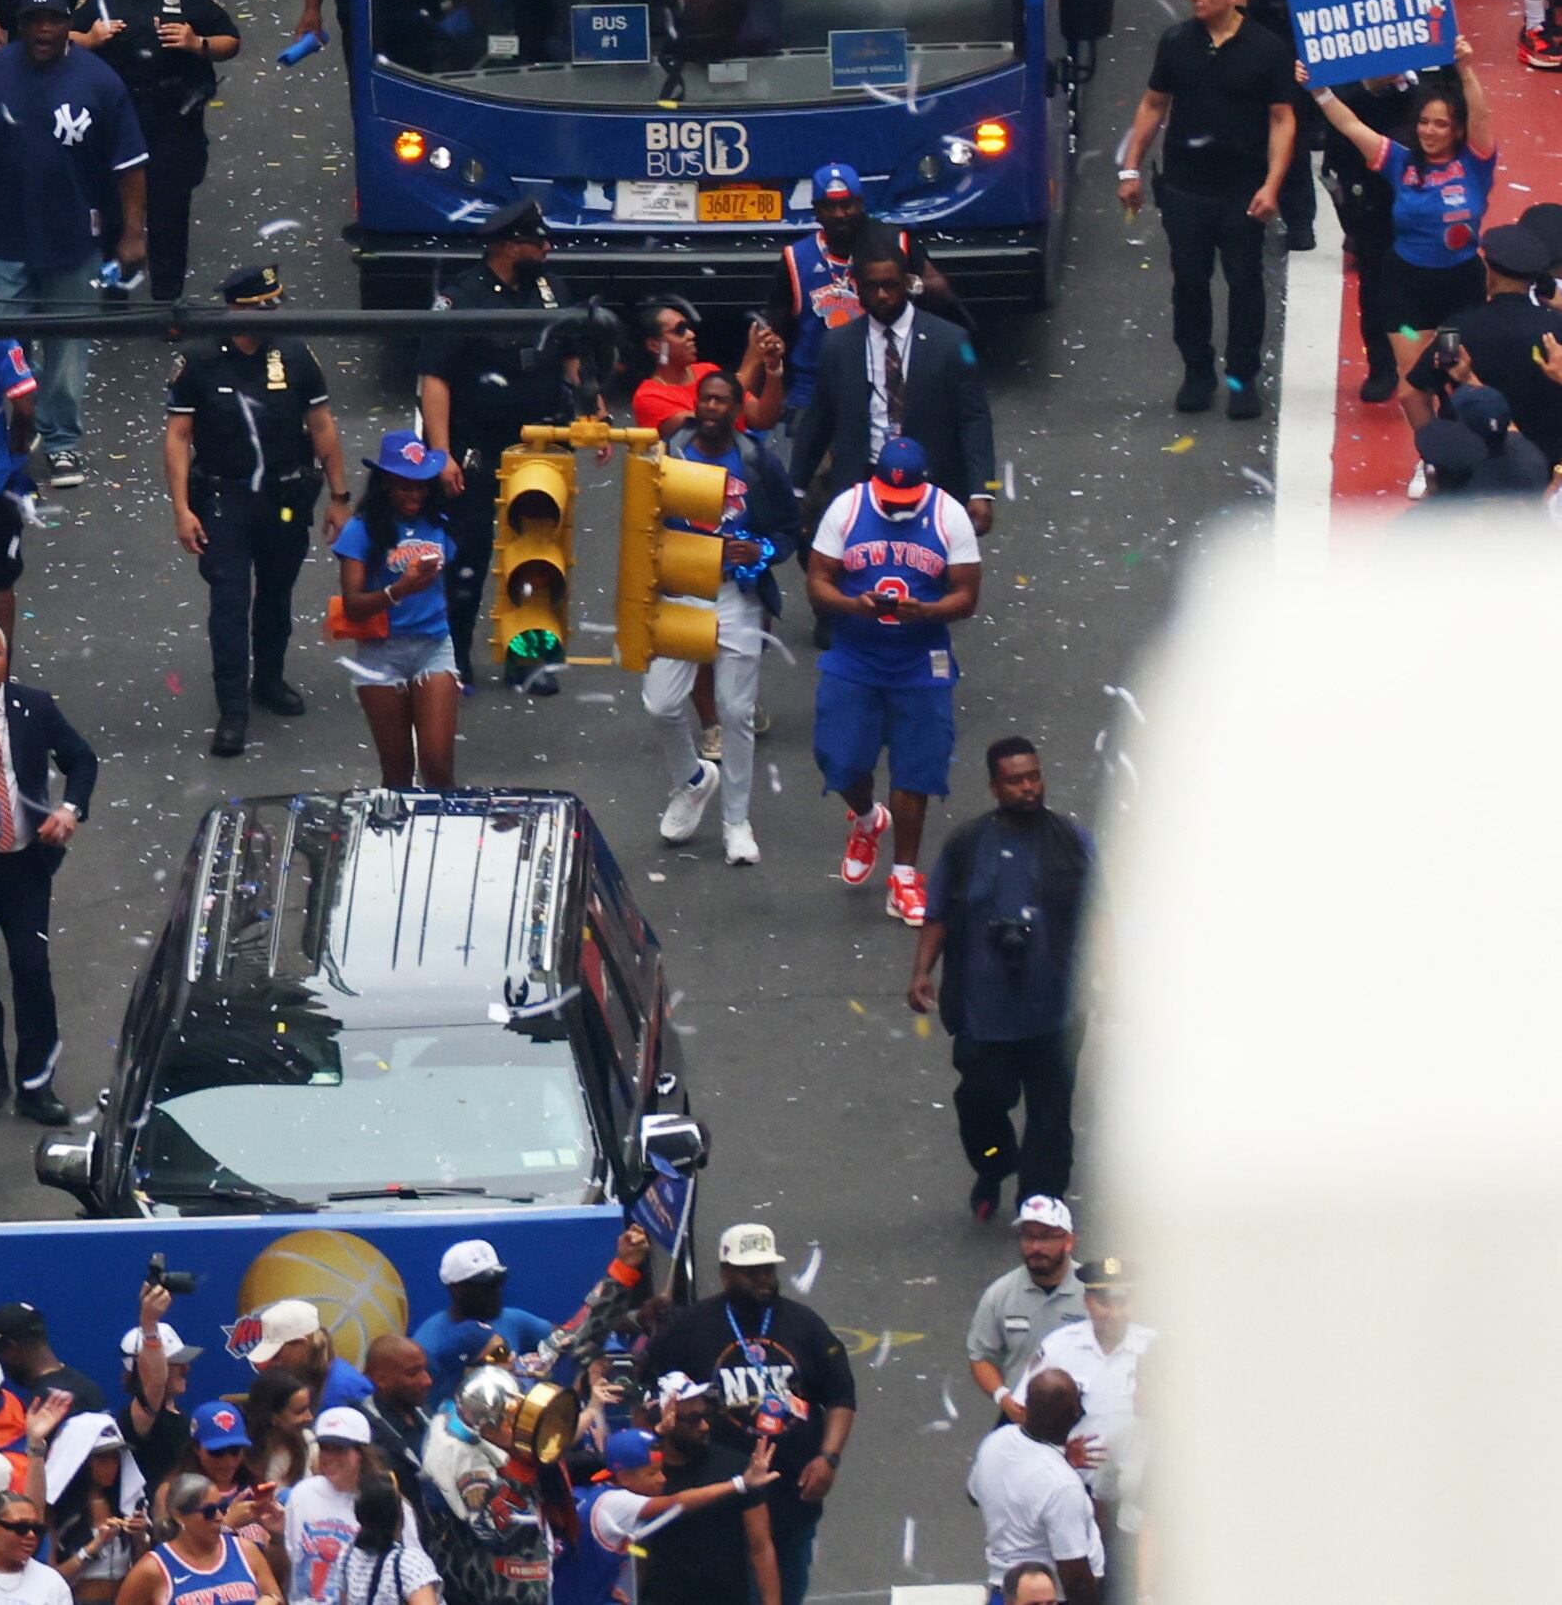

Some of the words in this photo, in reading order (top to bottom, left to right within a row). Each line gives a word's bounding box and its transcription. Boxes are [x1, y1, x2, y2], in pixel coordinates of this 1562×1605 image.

[591, 16, 628, 30] BUS
[1297, 0, 1350, 35] WON
[600, 34, 619, 48] #1
[53, 103, 92, 146] NY
[645, 121, 703, 150] BIG
[646, 150, 704, 177] BUS
